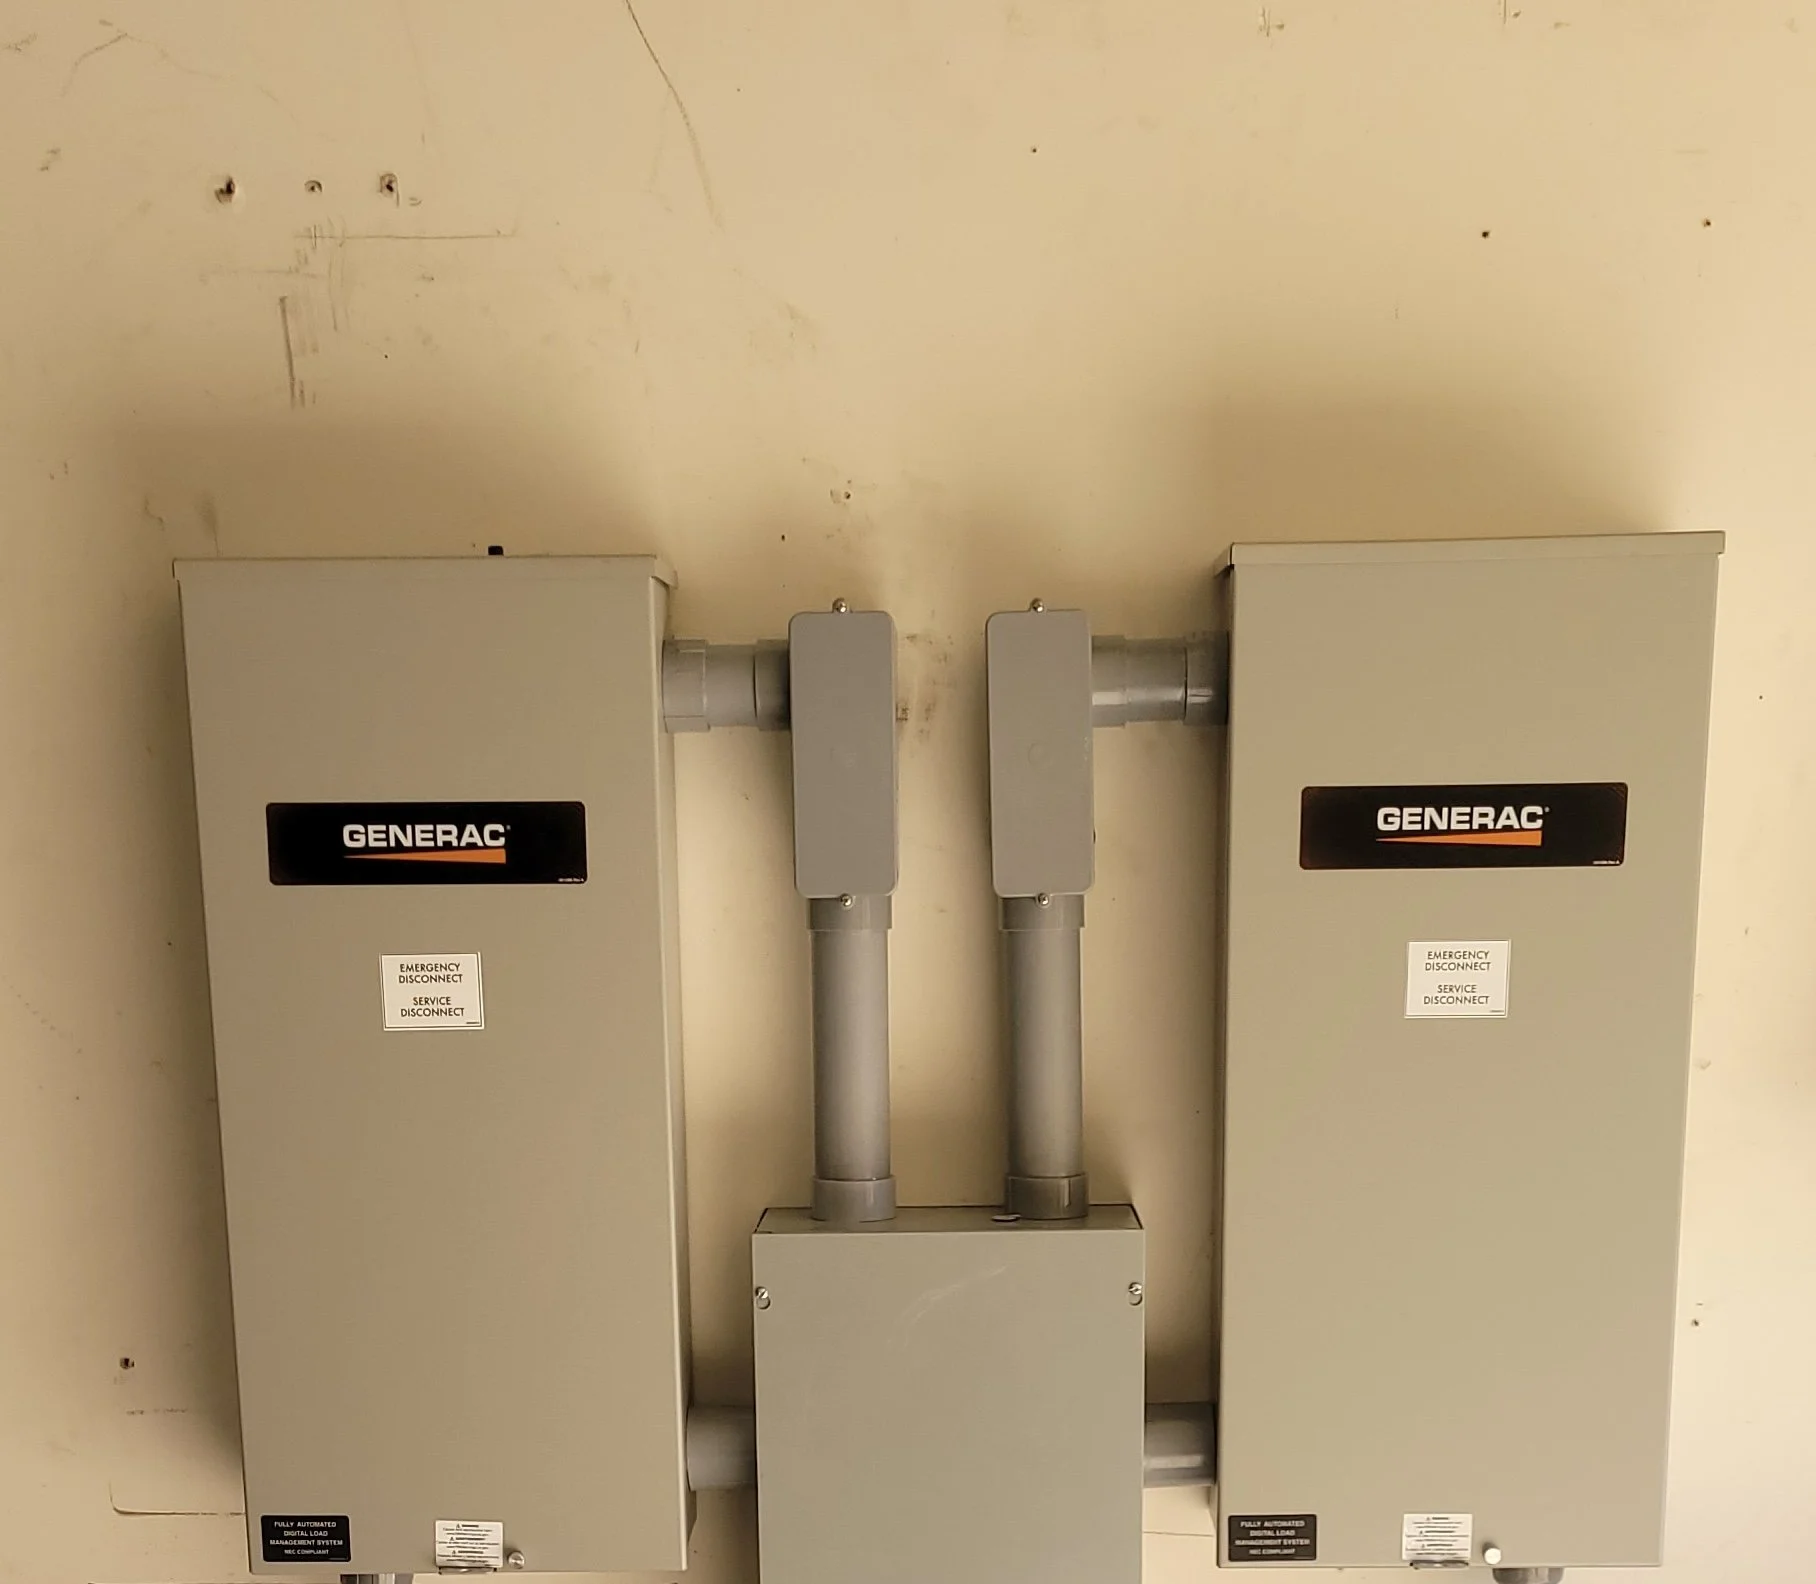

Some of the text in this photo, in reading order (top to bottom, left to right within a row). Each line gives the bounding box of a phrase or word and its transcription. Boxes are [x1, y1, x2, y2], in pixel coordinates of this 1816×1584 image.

[1377, 806, 1543, 831] GENERAC
[342, 823, 506, 848] GENERAC
[1427, 950, 1490, 960] EMERGENCY
[400, 962, 460, 973] EMERGENCY
[1425, 961, 1491, 971] DISCONNECT
[398, 973, 463, 984] DISCONNECT
[1437, 984, 1477, 993] SERVICE
[413, 996, 451, 1006] SERVICE
[1423, 995, 1489, 1005] DISCONNECT
[401, 1007, 465, 1017] DISCONNECT
